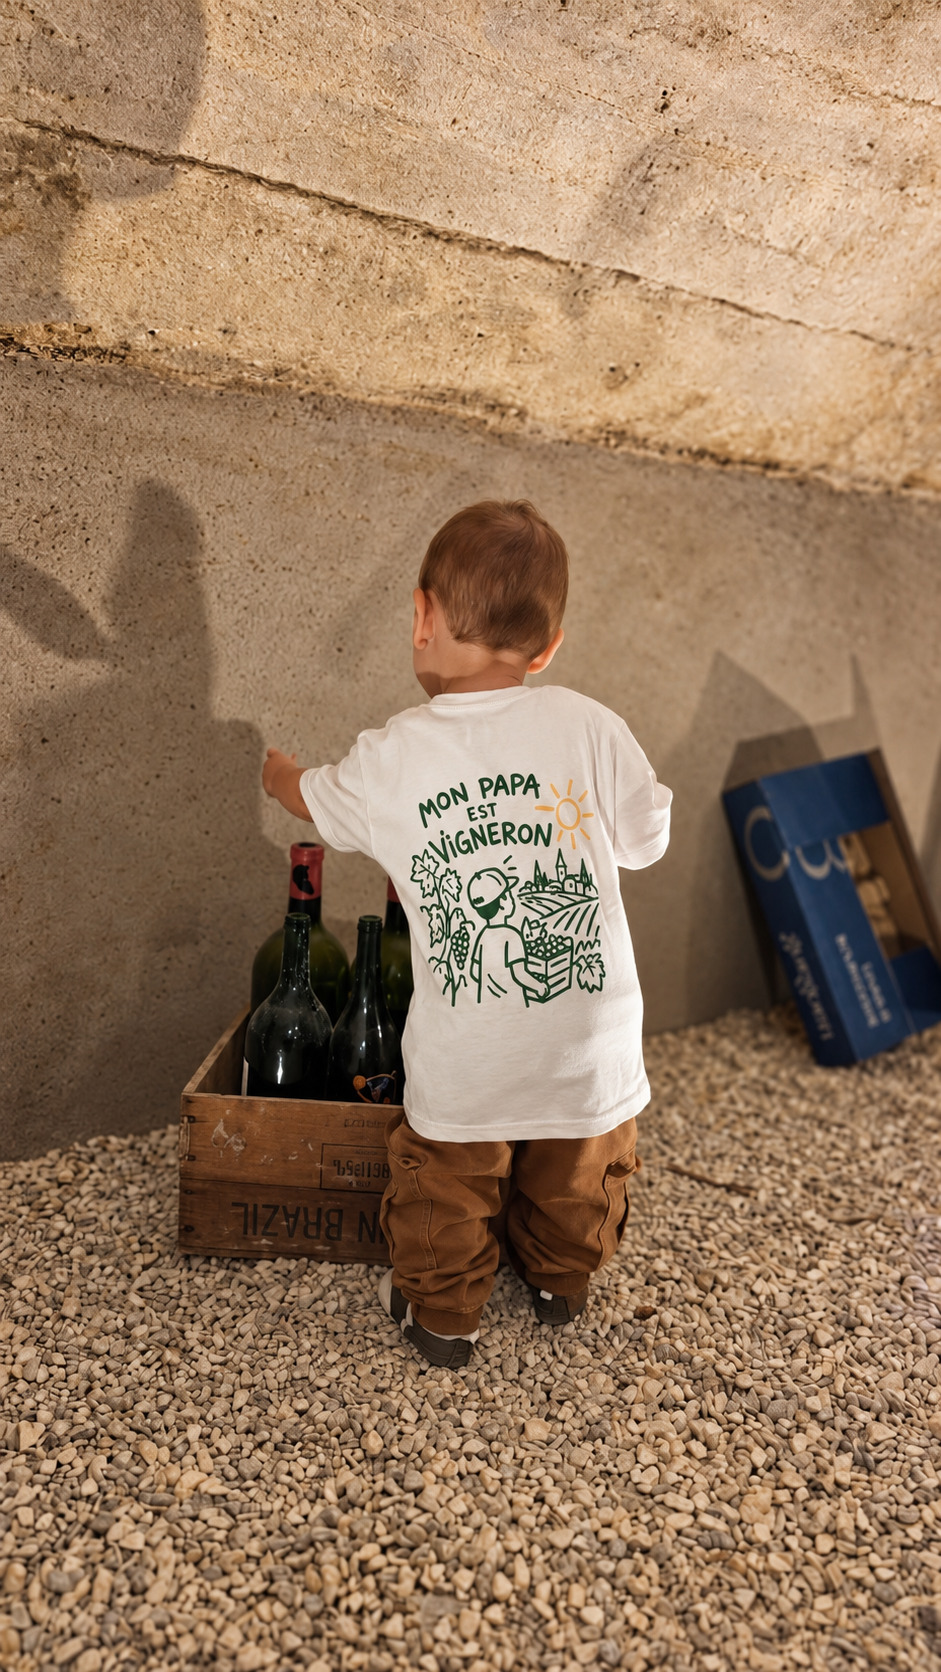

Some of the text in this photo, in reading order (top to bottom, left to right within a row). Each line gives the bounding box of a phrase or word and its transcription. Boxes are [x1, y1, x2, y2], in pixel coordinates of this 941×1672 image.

[418, 772, 541, 829] MON PAPA
[467, 802, 498, 822] EST
[231, 1202, 344, 1242] BRAZIL
